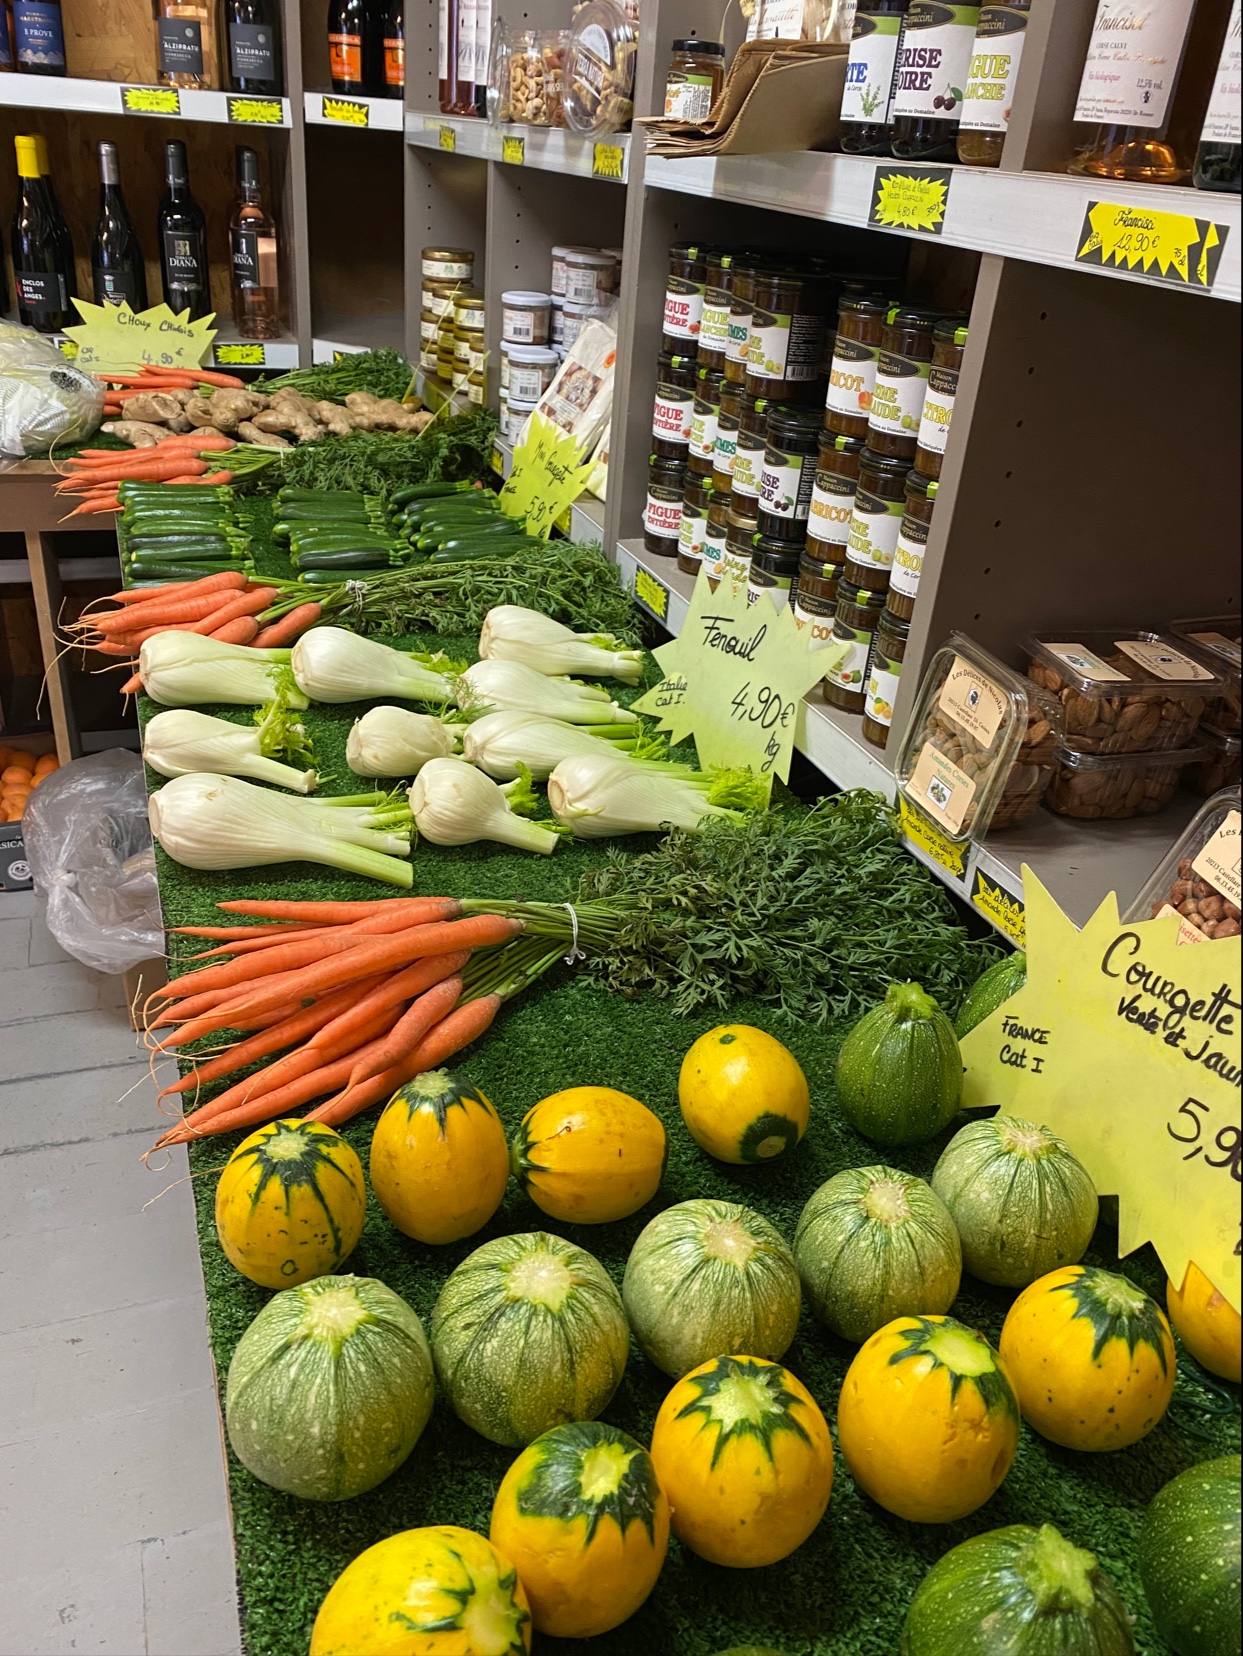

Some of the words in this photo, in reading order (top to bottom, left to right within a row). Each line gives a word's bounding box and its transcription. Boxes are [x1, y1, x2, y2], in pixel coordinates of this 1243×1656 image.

[1152, 235, 1160, 248] €
[170, 257, 198, 268] DIANA
[22, 279, 44, 287] ENCLOS
[648, 503, 681, 520] FIGUE
[952, 670, 963, 681] Les
[963, 668, 982, 684] Délices
[981, 679, 989, 689] de
[987, 685, 1003, 715] Nicolas
[935, 768, 956, 790] Natures
[951, 768, 969, 789] Corses
[1219, 828, 1237, 839] Les
[1206, 857, 1219, 870] 20213
[1218, 867, 1241, 889] Castellare
[1101, 932, 1241, 1035] Courgette
[1164, 1027, 1186, 1047] et
[1000, 1044, 1027, 1069] Cat
